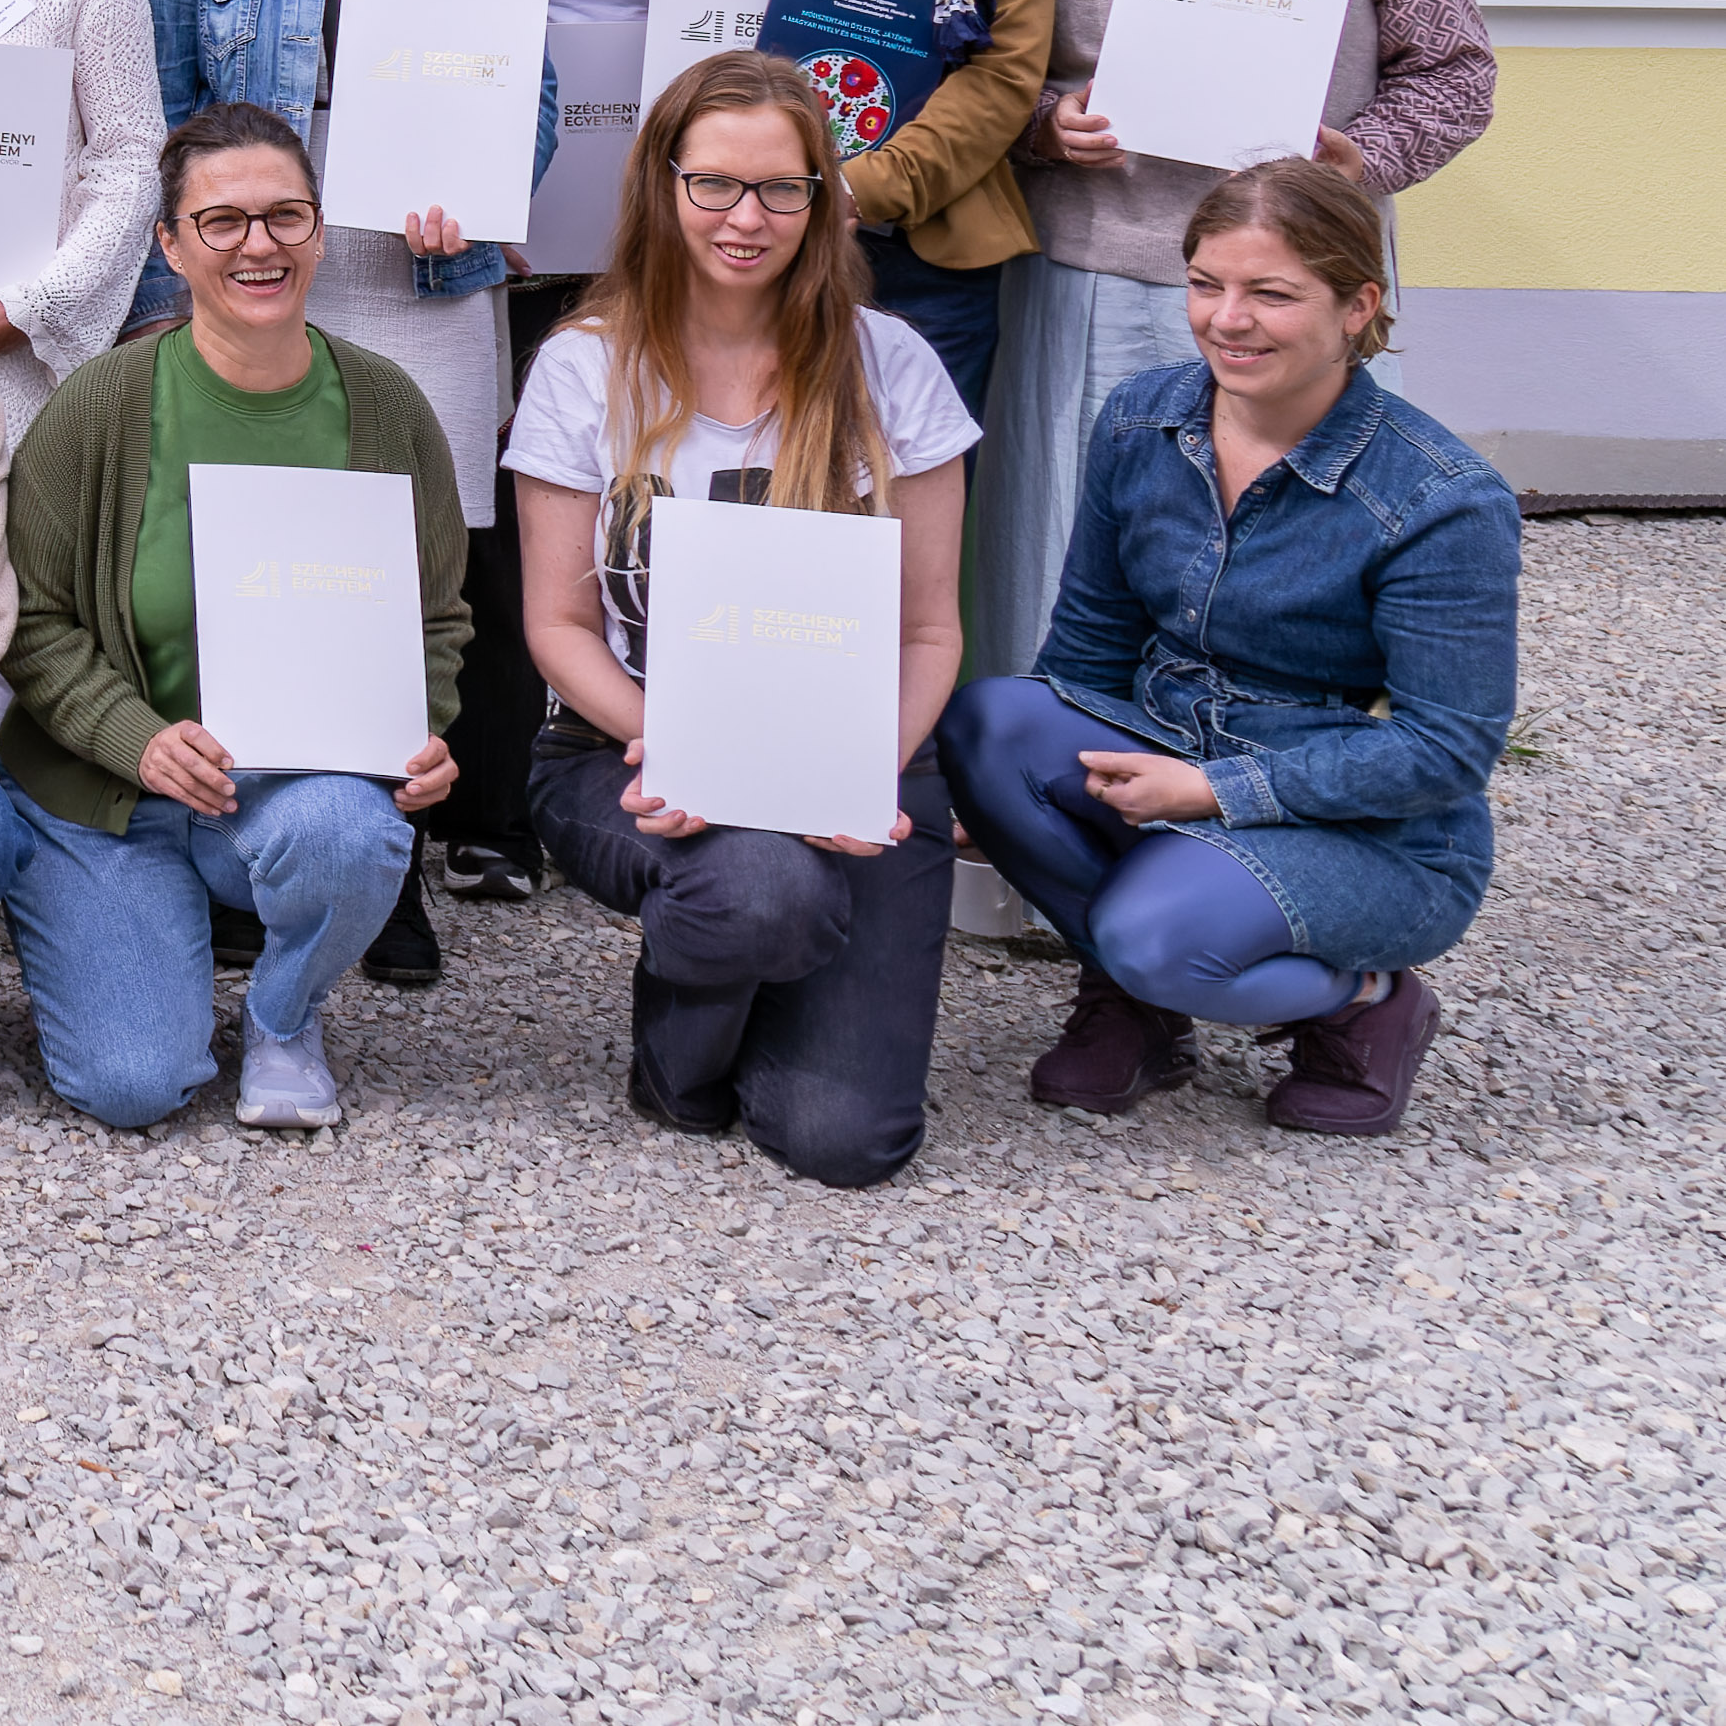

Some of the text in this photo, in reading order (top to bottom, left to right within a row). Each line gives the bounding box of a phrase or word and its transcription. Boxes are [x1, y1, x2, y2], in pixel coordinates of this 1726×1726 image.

[788, 16, 817, 29] MAGYAR
[817, 23, 839, 36] NYELV
[423, 50, 509, 66] SZÉCHENYI
[422, 64, 494, 78] EGYETEM
[564, 101, 641, 115] SZÉCHENY
[564, 115, 633, 127] EGYETEM
[291, 561, 385, 581] SZÉCHENYI
[292, 577, 372, 594] EGYETEM
[752, 608, 860, 632] SZÉCHENYI
[752, 624, 842, 644] EGYETEM
